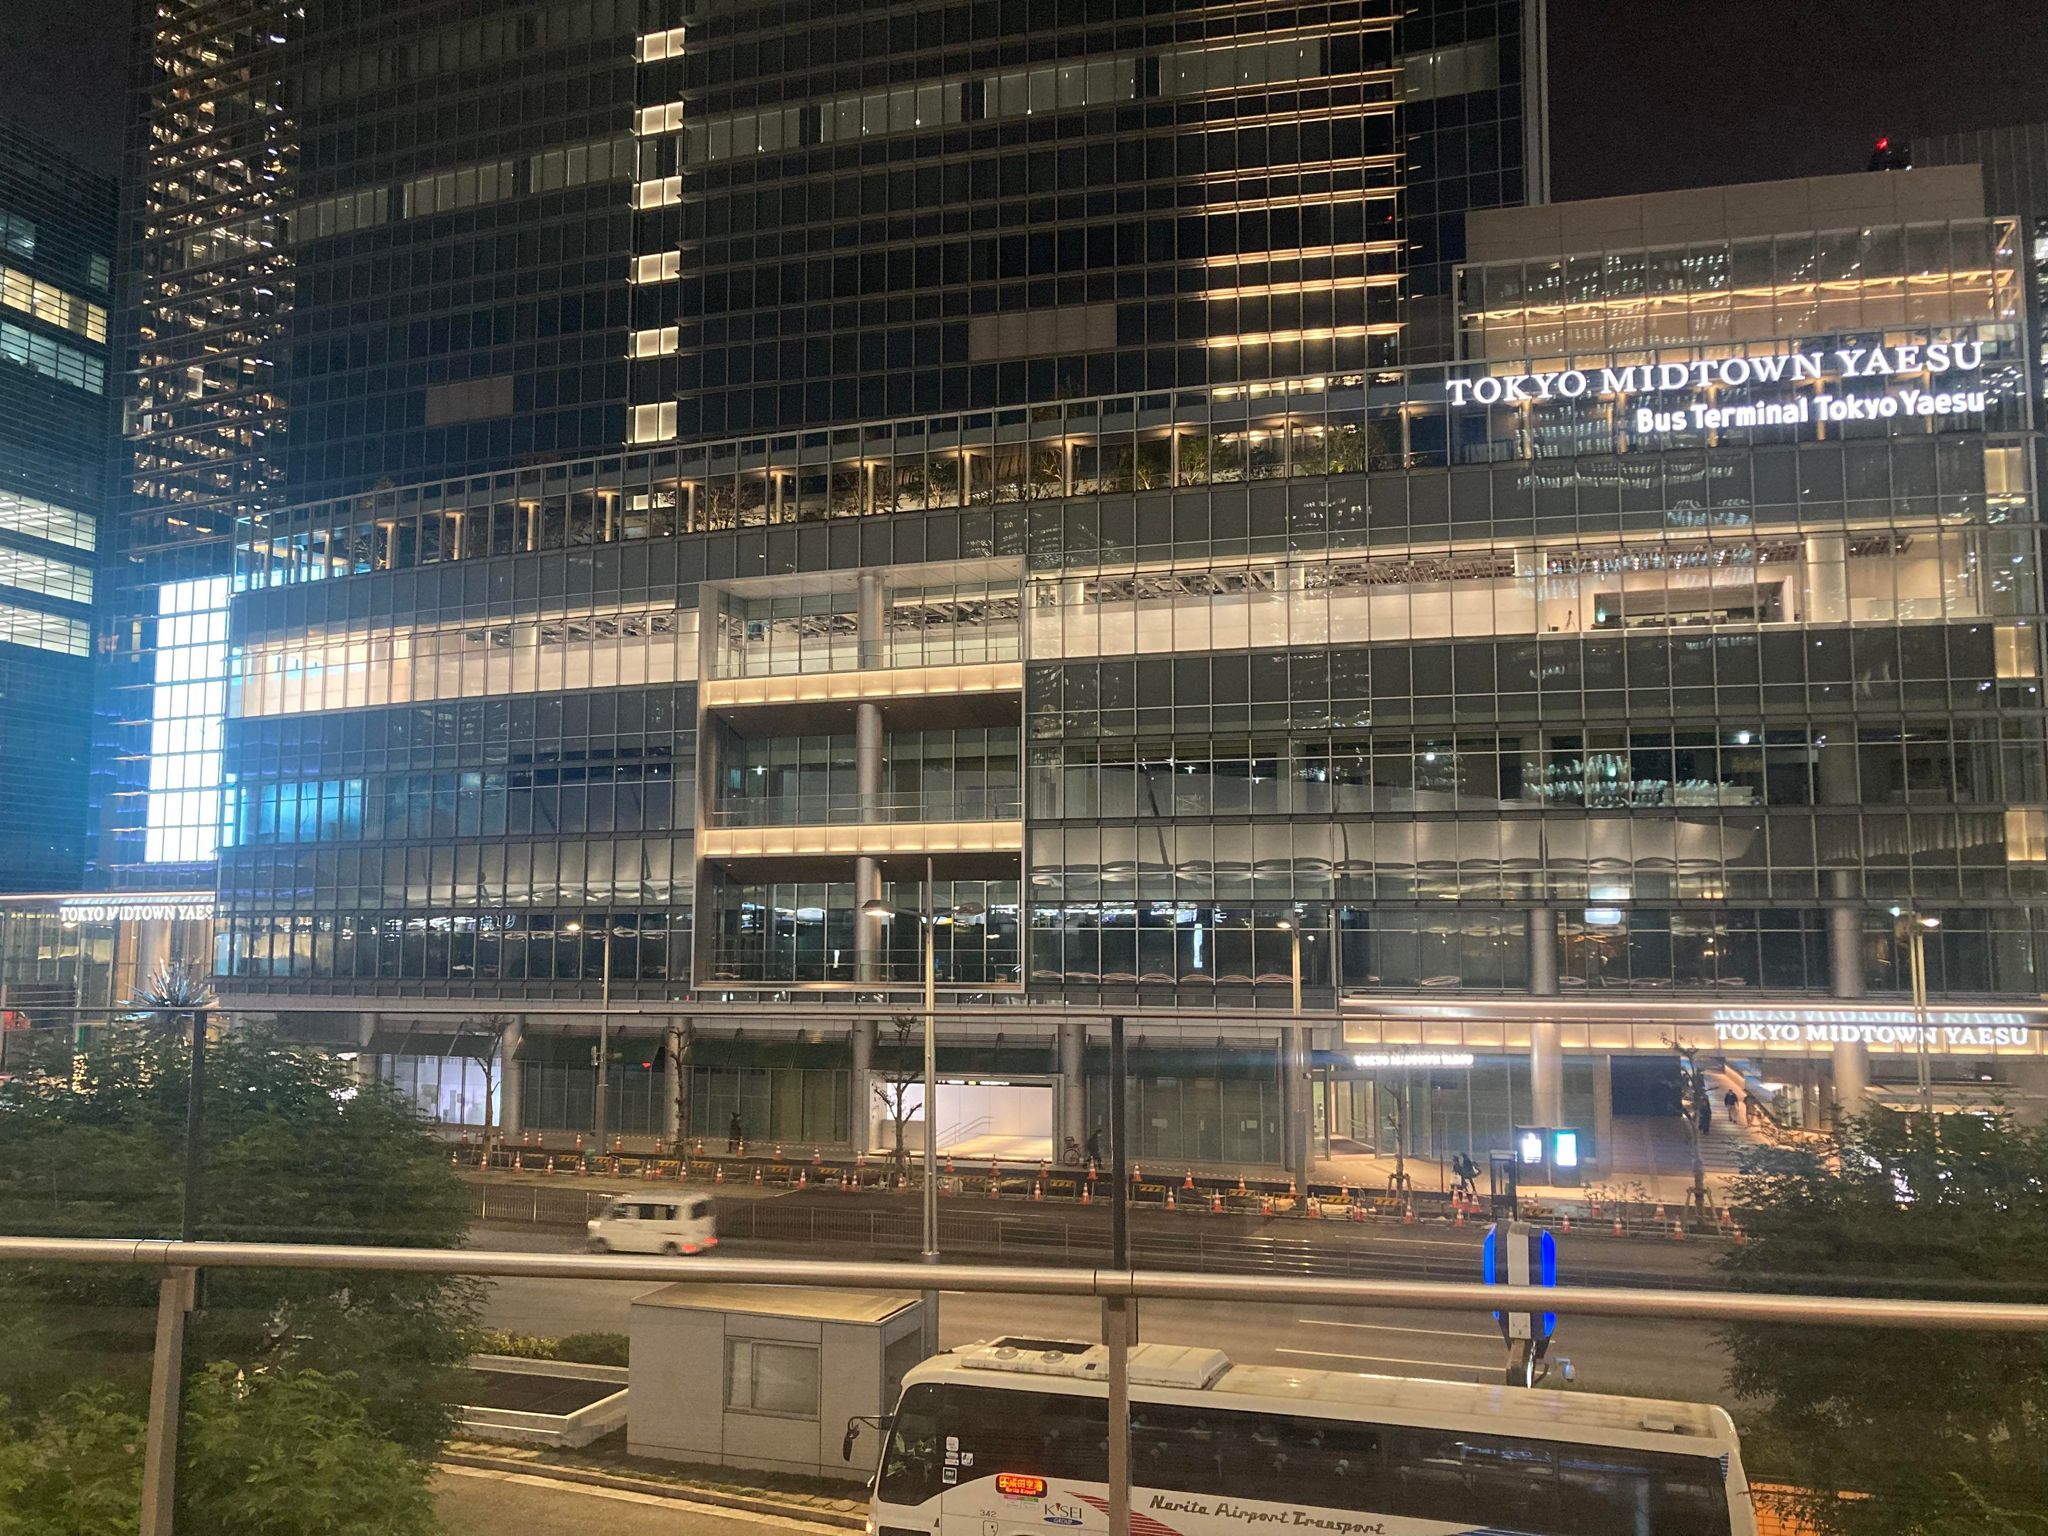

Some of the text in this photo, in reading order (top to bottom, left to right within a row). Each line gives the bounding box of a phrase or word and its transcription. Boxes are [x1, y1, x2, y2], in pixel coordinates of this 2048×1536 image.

[1446, 341, 1984, 406] TOKYO MIDTOWN YAESU
[1636, 389, 1985, 433] Bus Terminal Tokyo Yaesu
[59, 906, 104, 922] TOKYO
[106, 905, 177, 921] MIDTOWN
[1714, 1023, 2029, 1045] TOKYO MIDTOWN YAESU
[980, 1509, 997, 1518] 342
[1150, 1495, 1386, 1535] Narita Airport Transport
